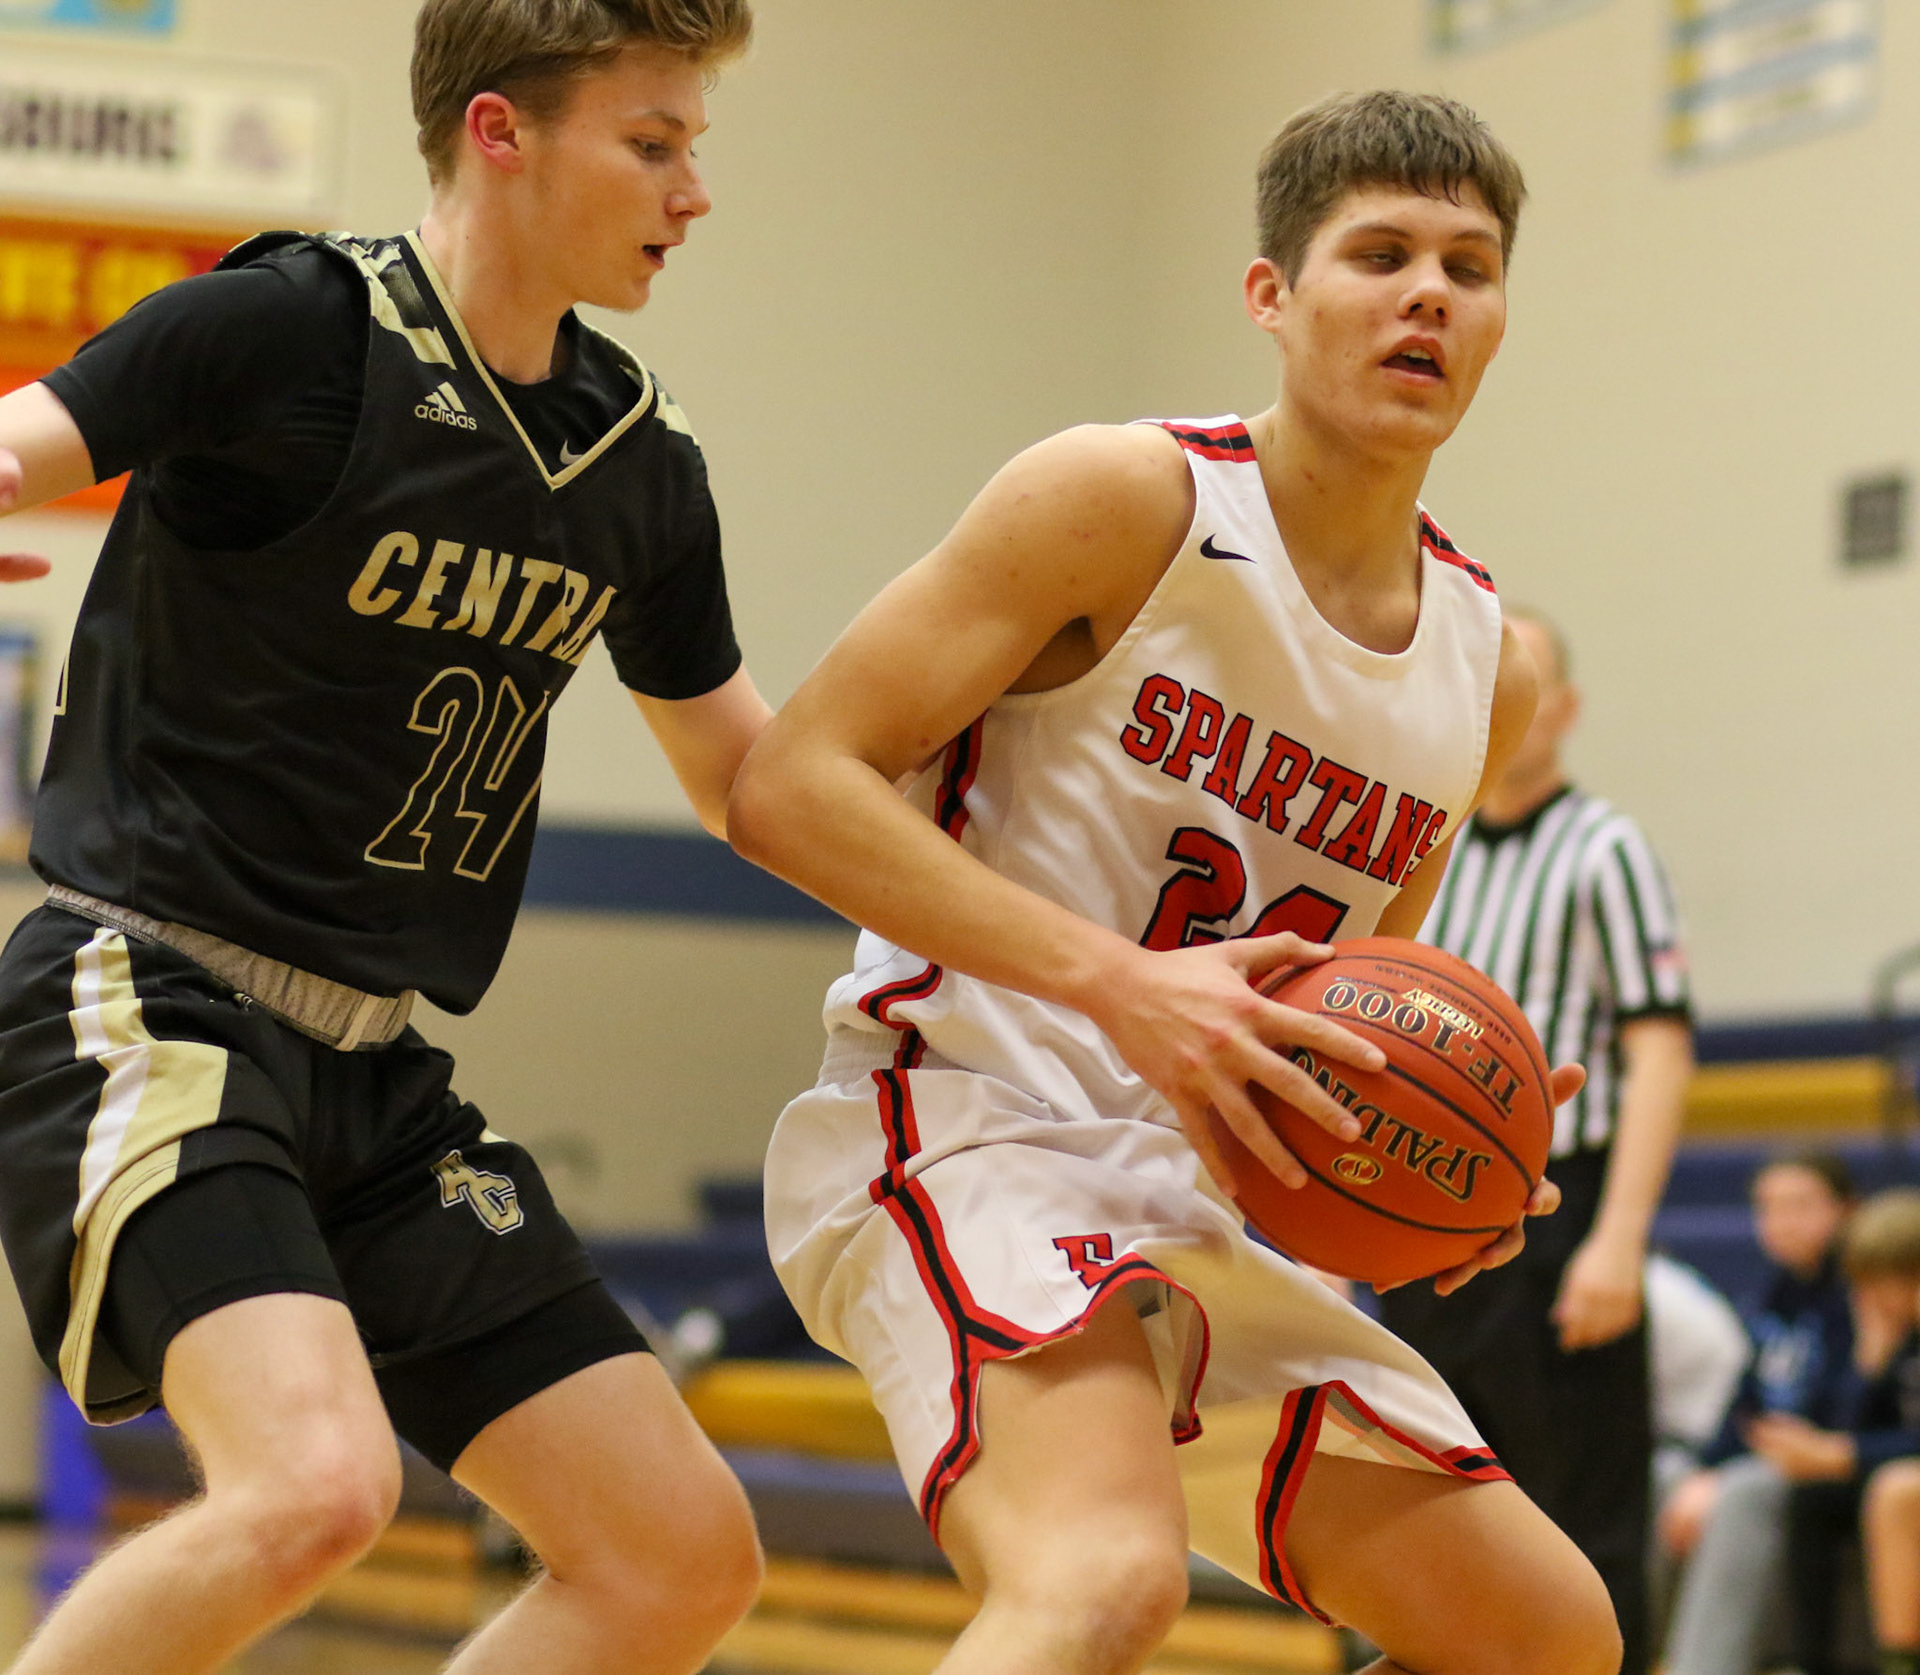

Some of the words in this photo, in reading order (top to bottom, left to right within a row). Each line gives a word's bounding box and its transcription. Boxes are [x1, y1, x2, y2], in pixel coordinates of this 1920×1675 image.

[414, 402, 478, 431] adidas
[363, 665, 551, 883] 24
[1119, 672, 1448, 888] SPARTANS
[1321, 981, 1520, 1116] TF-1000
[1401, 987, 1485, 1041] LEGACY
